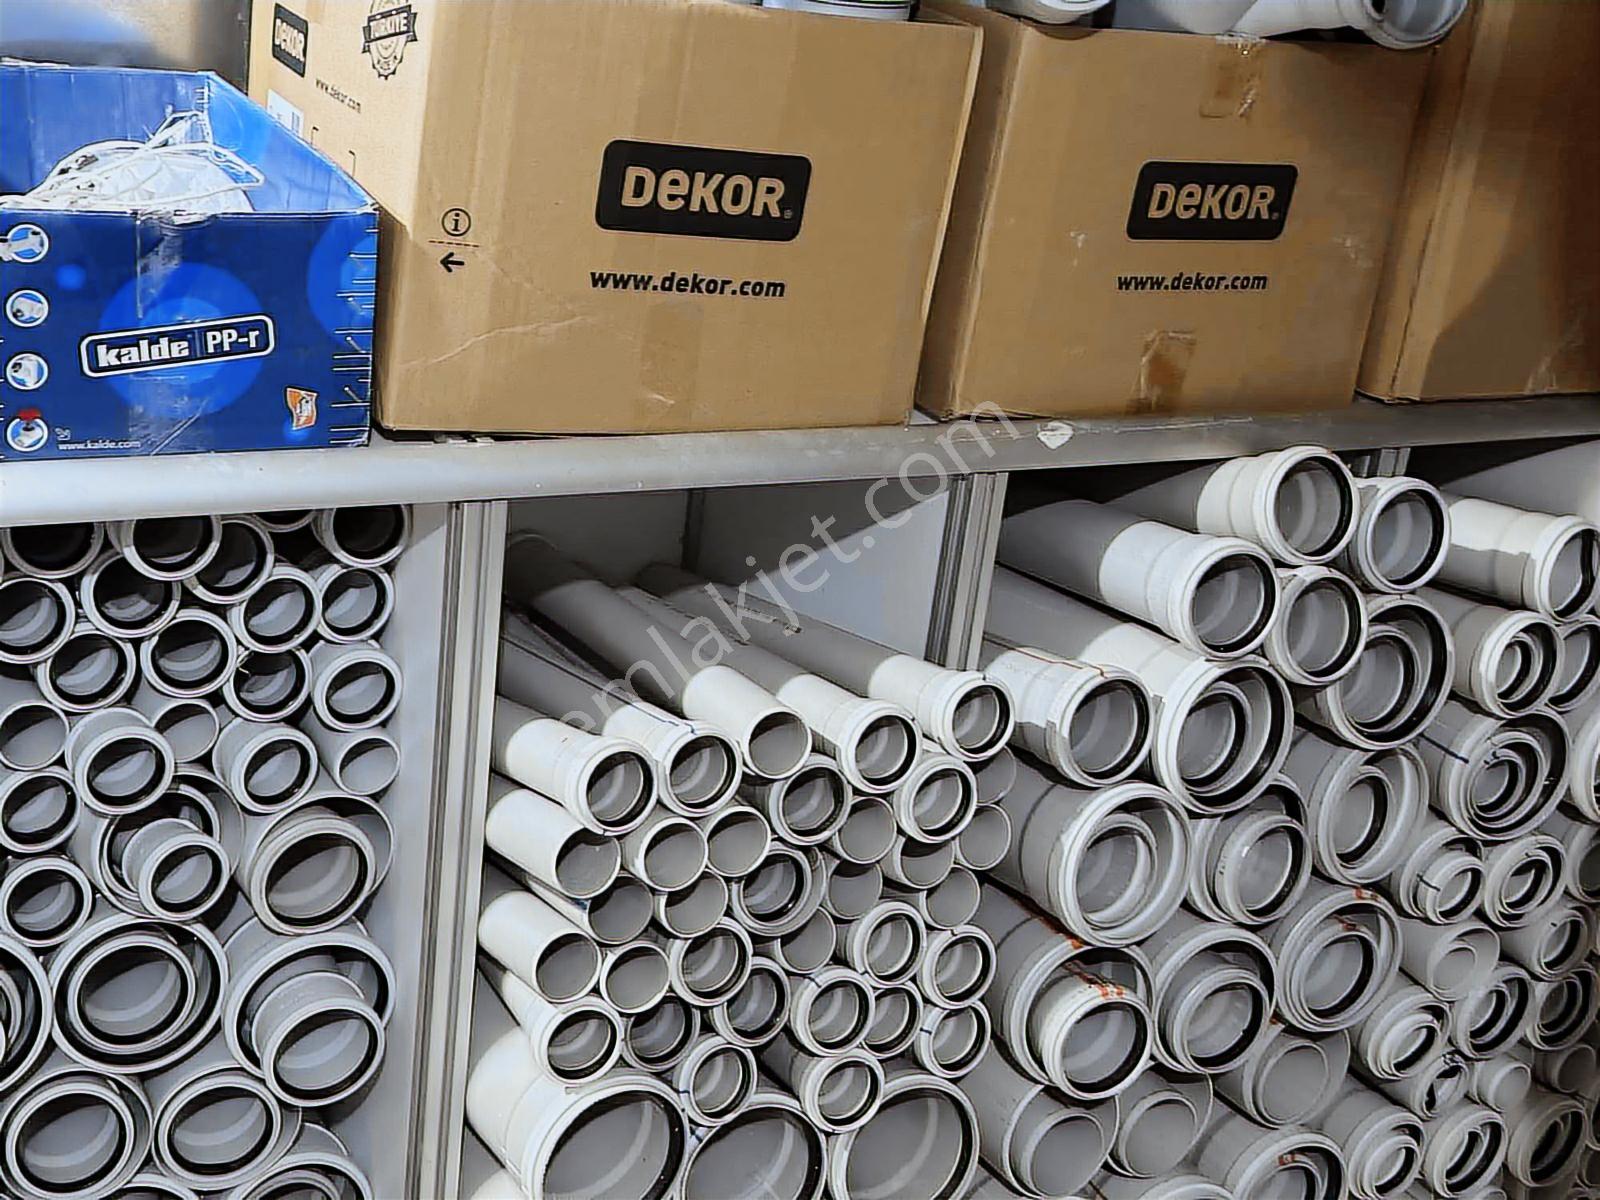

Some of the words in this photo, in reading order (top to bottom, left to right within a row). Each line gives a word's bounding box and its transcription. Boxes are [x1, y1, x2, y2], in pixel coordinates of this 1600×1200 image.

[590, 270, 785, 297] www.dekor.com
[1117, 272, 1268, 290] www.dekor.com
[97, 337, 190, 367] kalde
[206, 328, 260, 354] PP-r
